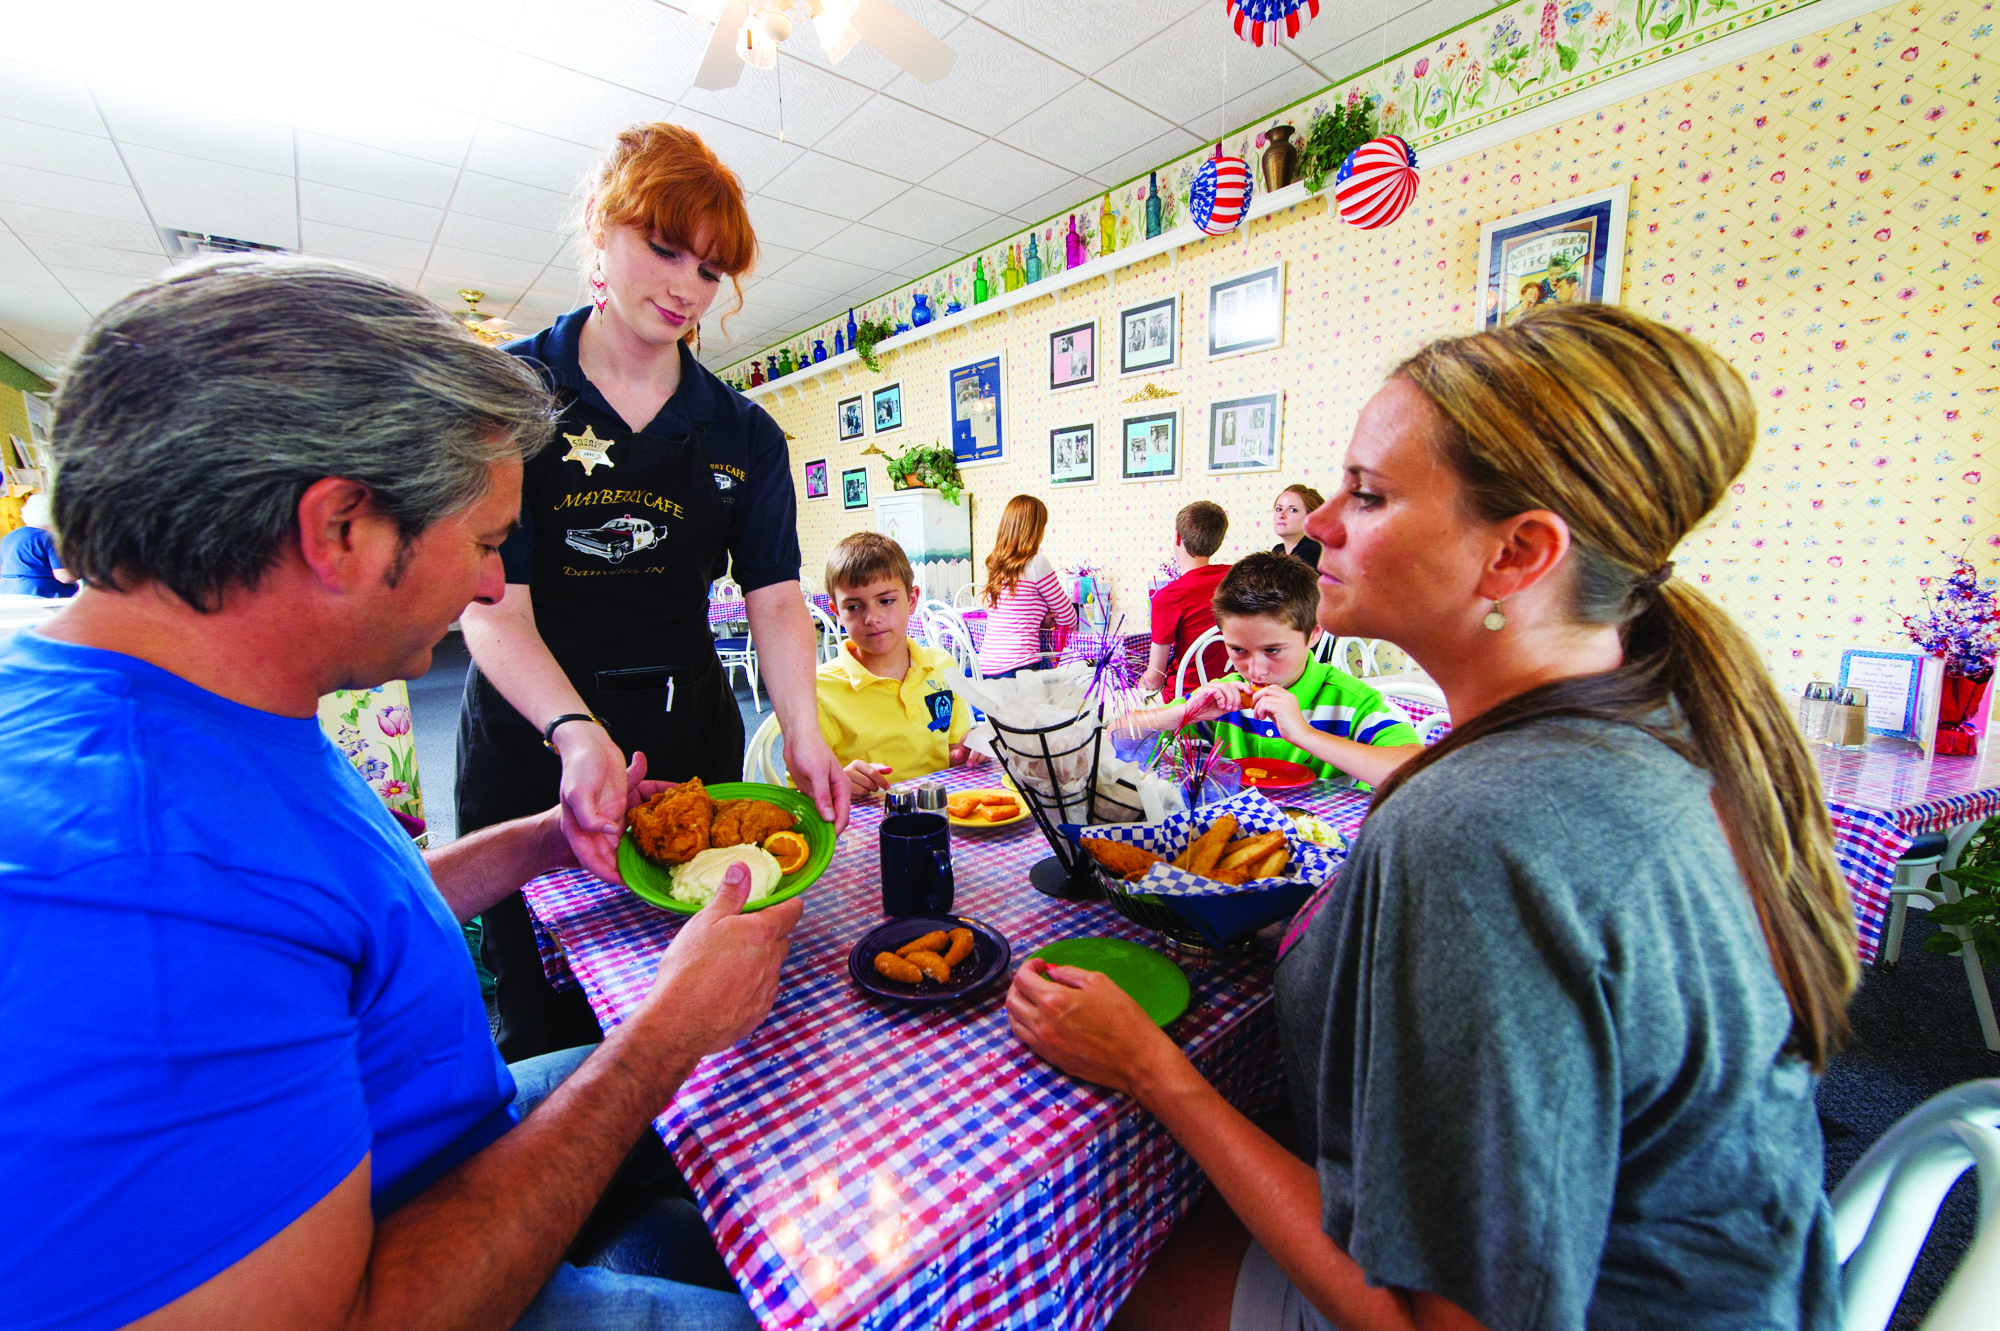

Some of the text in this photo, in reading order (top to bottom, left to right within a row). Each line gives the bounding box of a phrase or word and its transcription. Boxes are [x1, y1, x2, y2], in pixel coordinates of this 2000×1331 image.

[1511, 245, 1583, 269] KITCHEN
[725, 464, 746, 482] CAFE
[554, 489, 684, 519] MAYBERRY CAFE
[644, 566, 665, 574] IN
